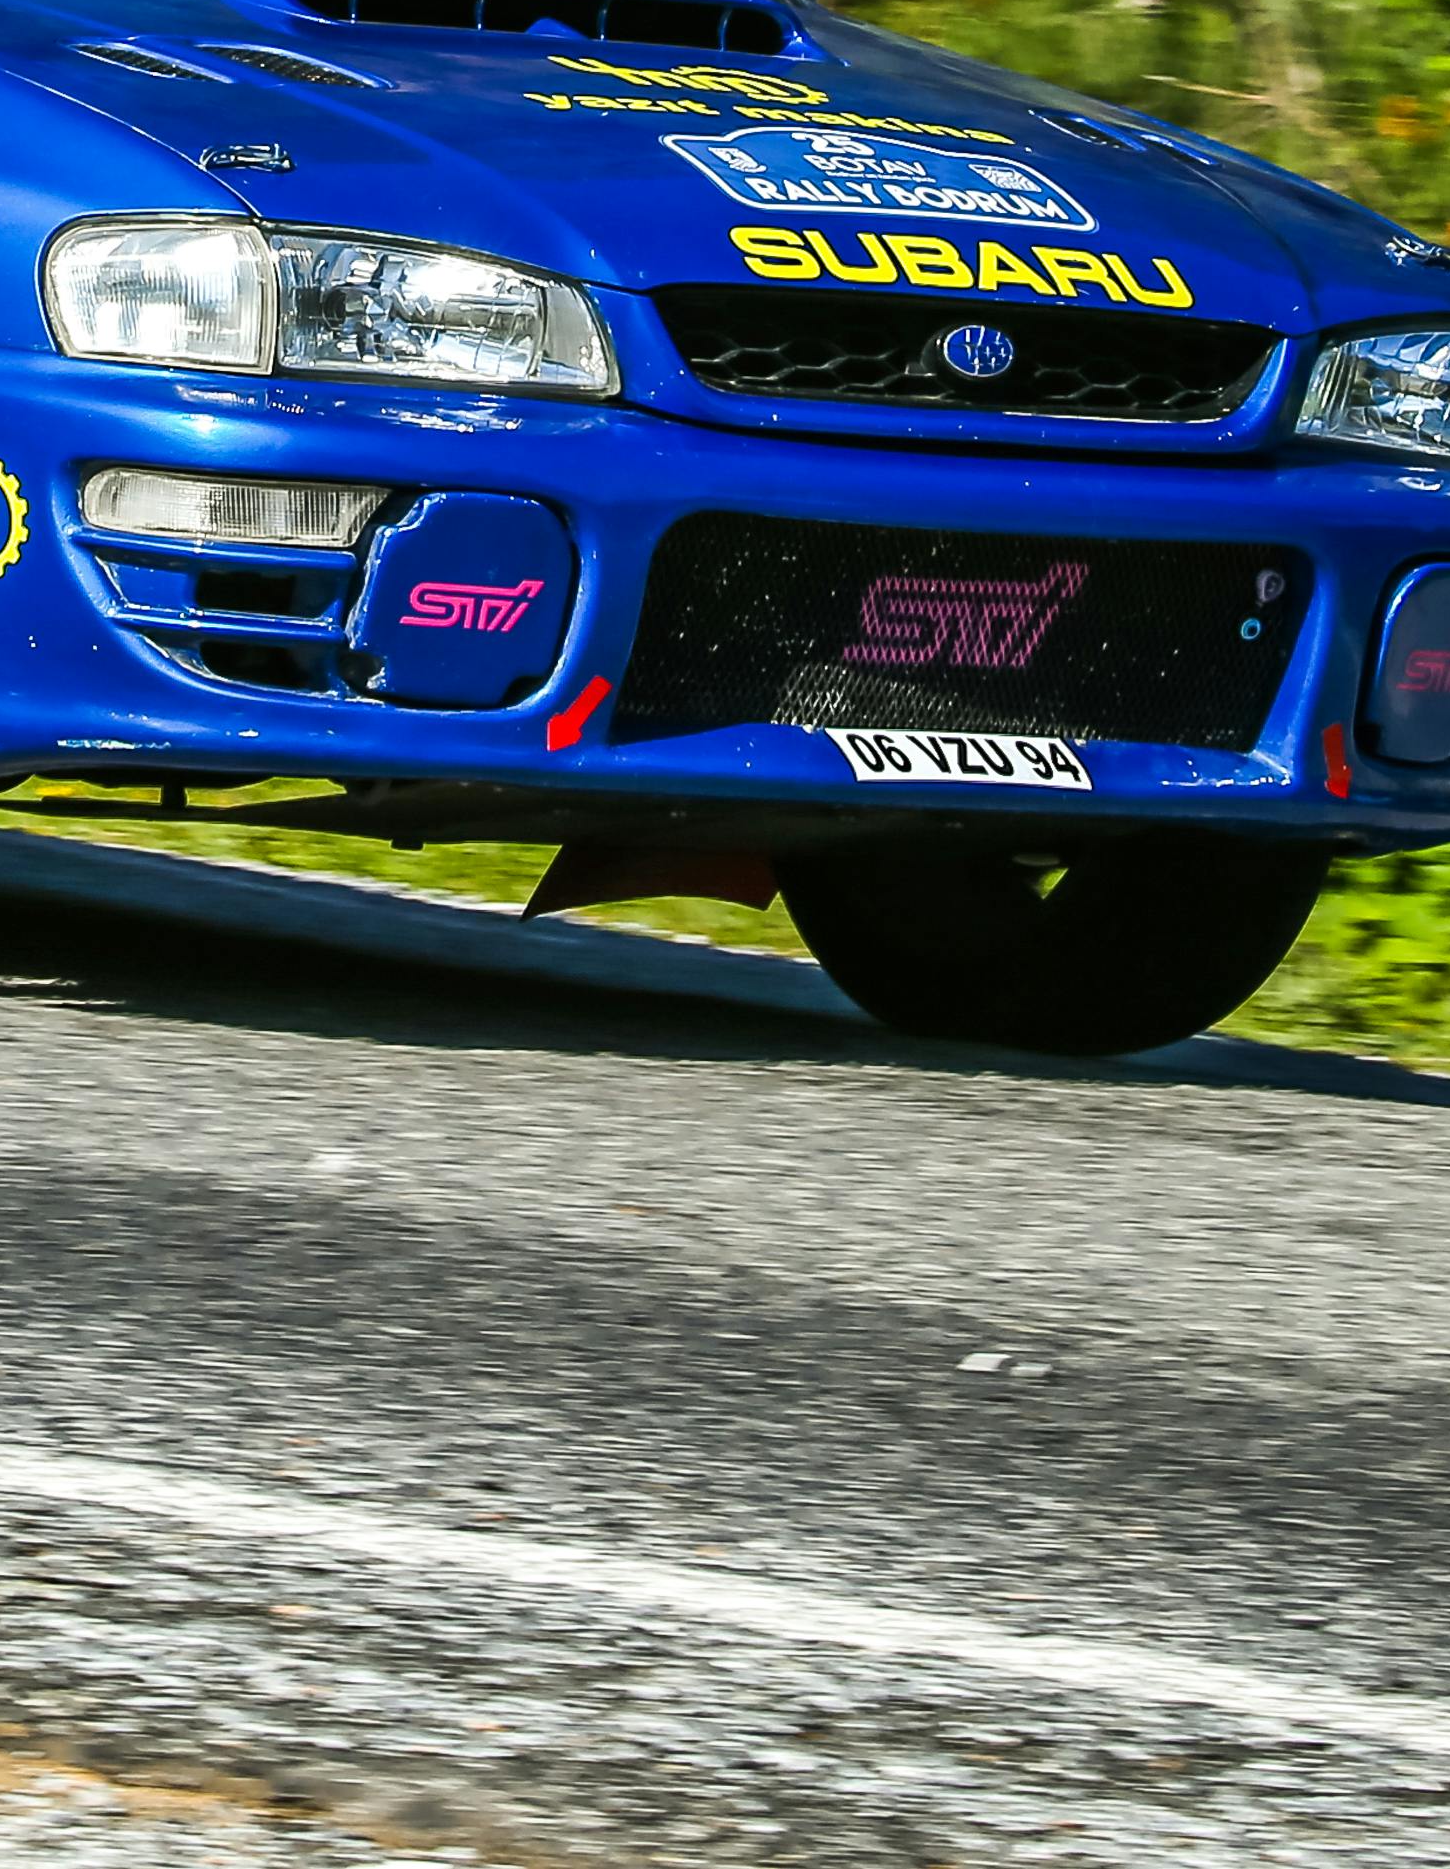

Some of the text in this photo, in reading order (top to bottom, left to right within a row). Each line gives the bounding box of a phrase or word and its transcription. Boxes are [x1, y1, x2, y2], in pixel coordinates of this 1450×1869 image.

[791, 132, 877, 156] 25
[803, 154, 928, 178] BOTAV
[743, 177, 885, 205] RALLY
[893, 183, 1071, 221] BODRUM
[729, 226, 1195, 309] SUBARU
[846, 733, 1082, 783] 06 VZU 94
